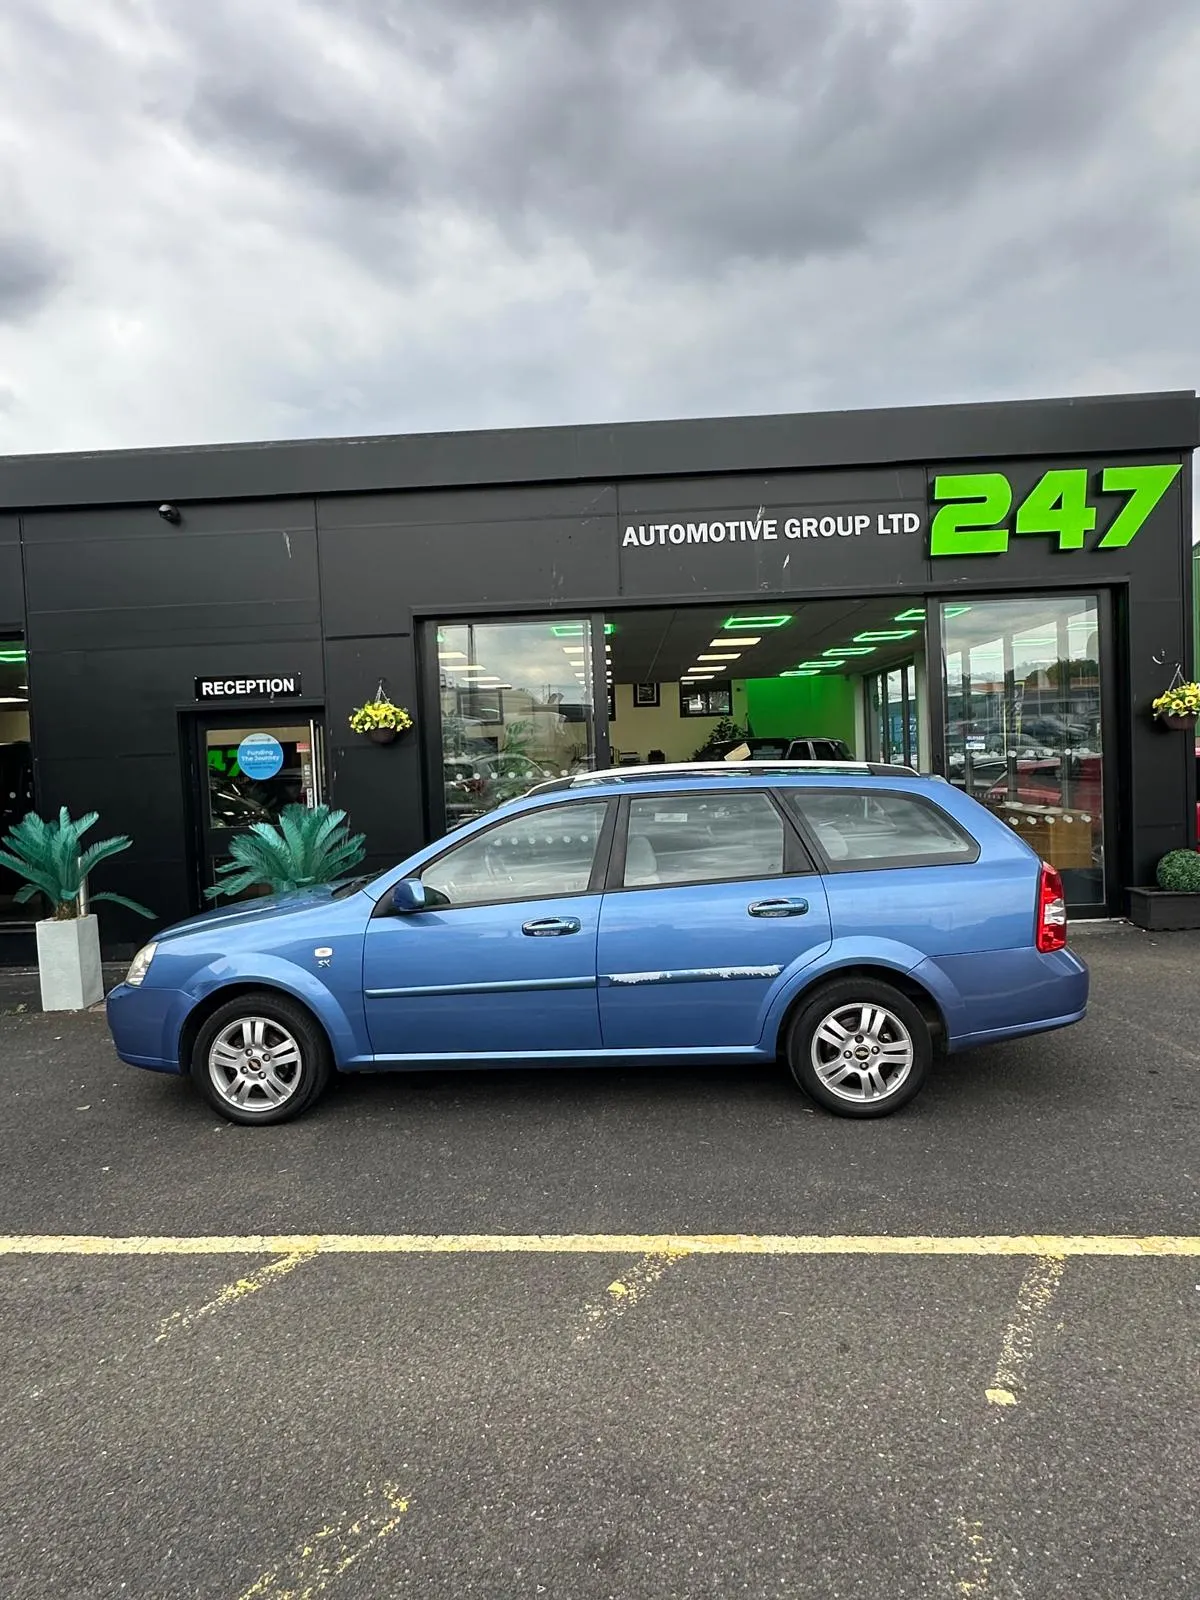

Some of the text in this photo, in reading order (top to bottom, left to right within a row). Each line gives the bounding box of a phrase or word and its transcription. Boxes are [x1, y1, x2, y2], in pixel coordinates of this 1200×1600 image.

[930, 463, 1184, 556] 247
[622, 513, 921, 547] AUTOMOTIVE GROUP LTD
[201, 678, 295, 696] RECEPTION
